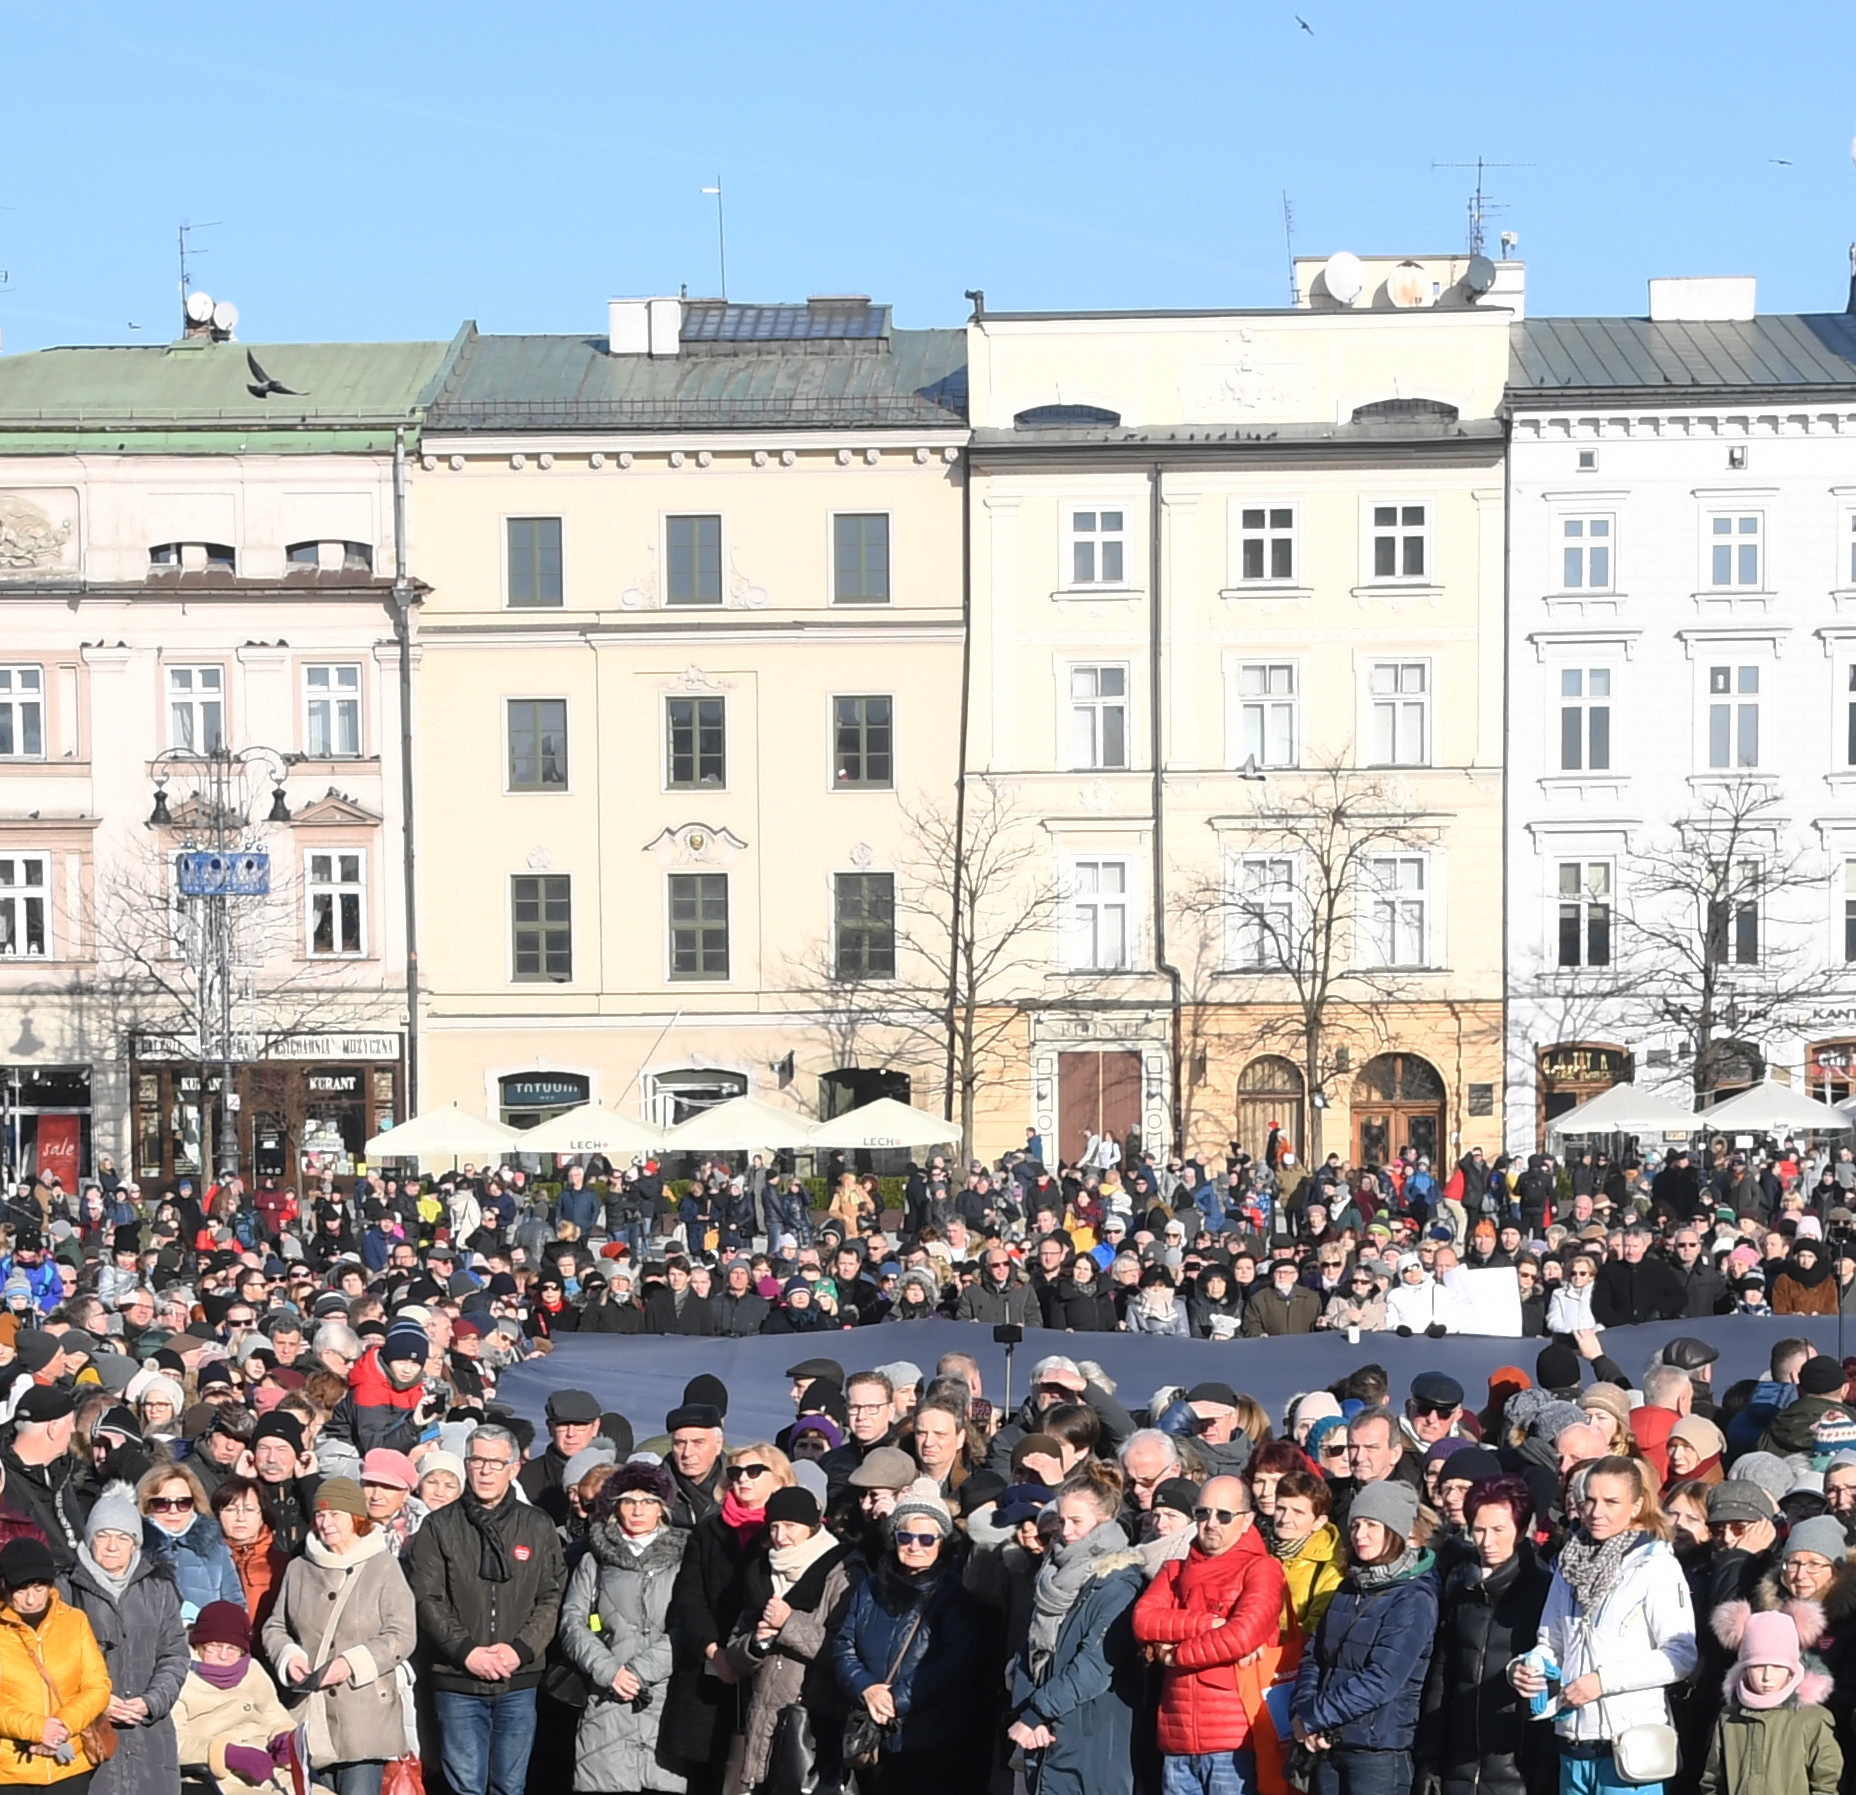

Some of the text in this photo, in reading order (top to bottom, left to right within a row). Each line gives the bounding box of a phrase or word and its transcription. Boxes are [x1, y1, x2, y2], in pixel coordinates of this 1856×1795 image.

[309, 1076, 356, 1090] KURANT
[42, 1137, 75, 1157] sale
[570, 1141, 601, 1149] LECH
[863, 1137, 894, 1146] LECH
